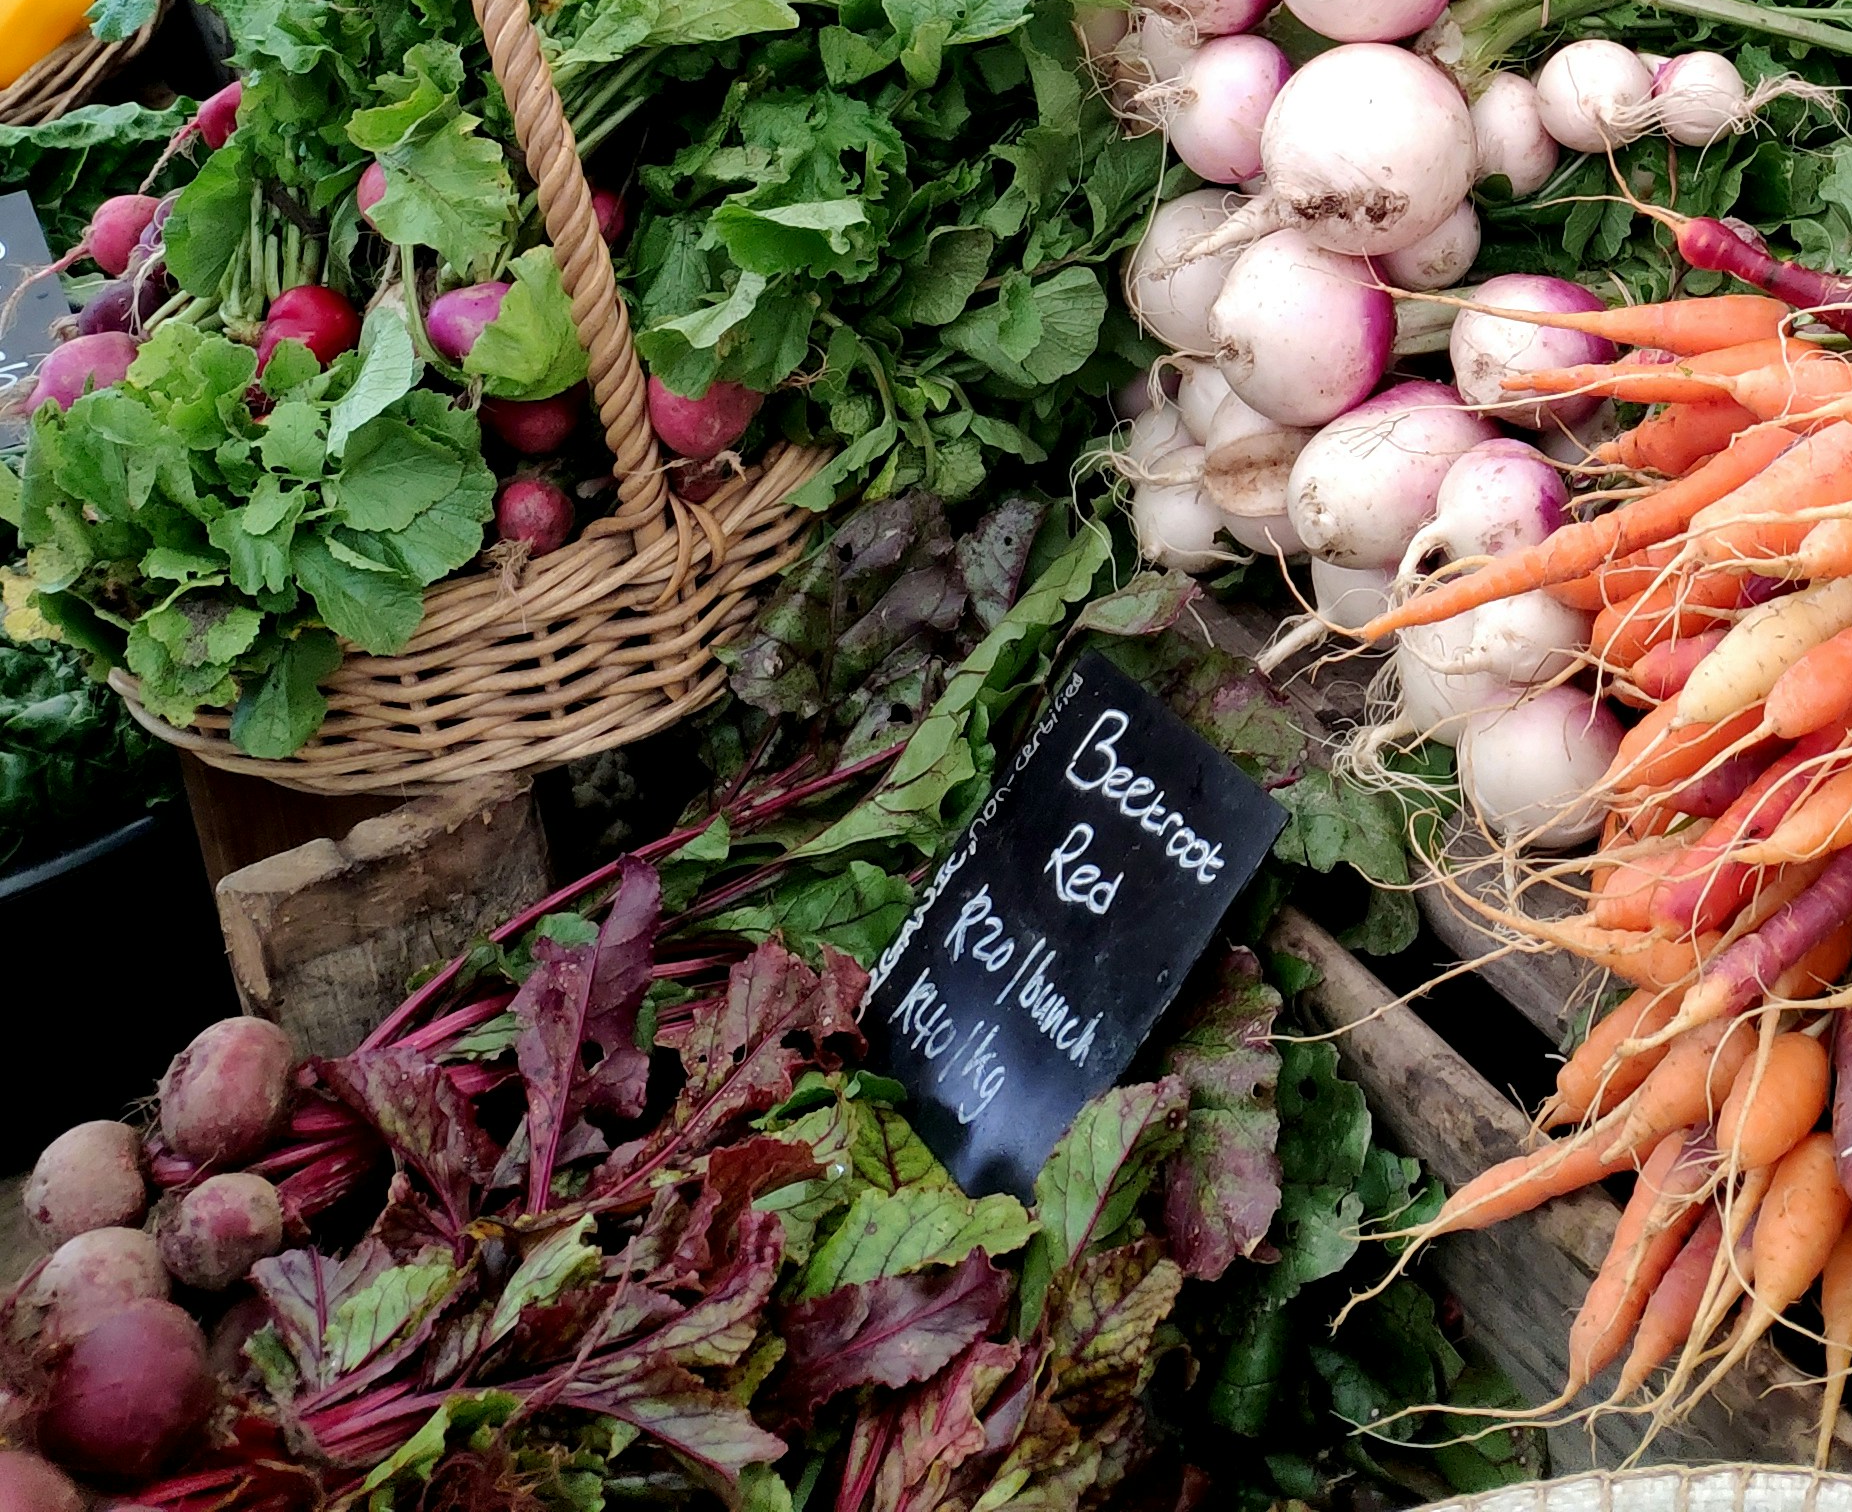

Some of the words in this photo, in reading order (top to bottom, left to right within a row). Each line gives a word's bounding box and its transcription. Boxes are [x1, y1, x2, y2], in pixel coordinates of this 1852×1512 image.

[1044, 823, 1124, 915] Red
[1066, 708, 1225, 885] Beetroot
[888, 967, 1007, 1125] R40/kg
[944, 884, 1104, 1068] R20/bunch
